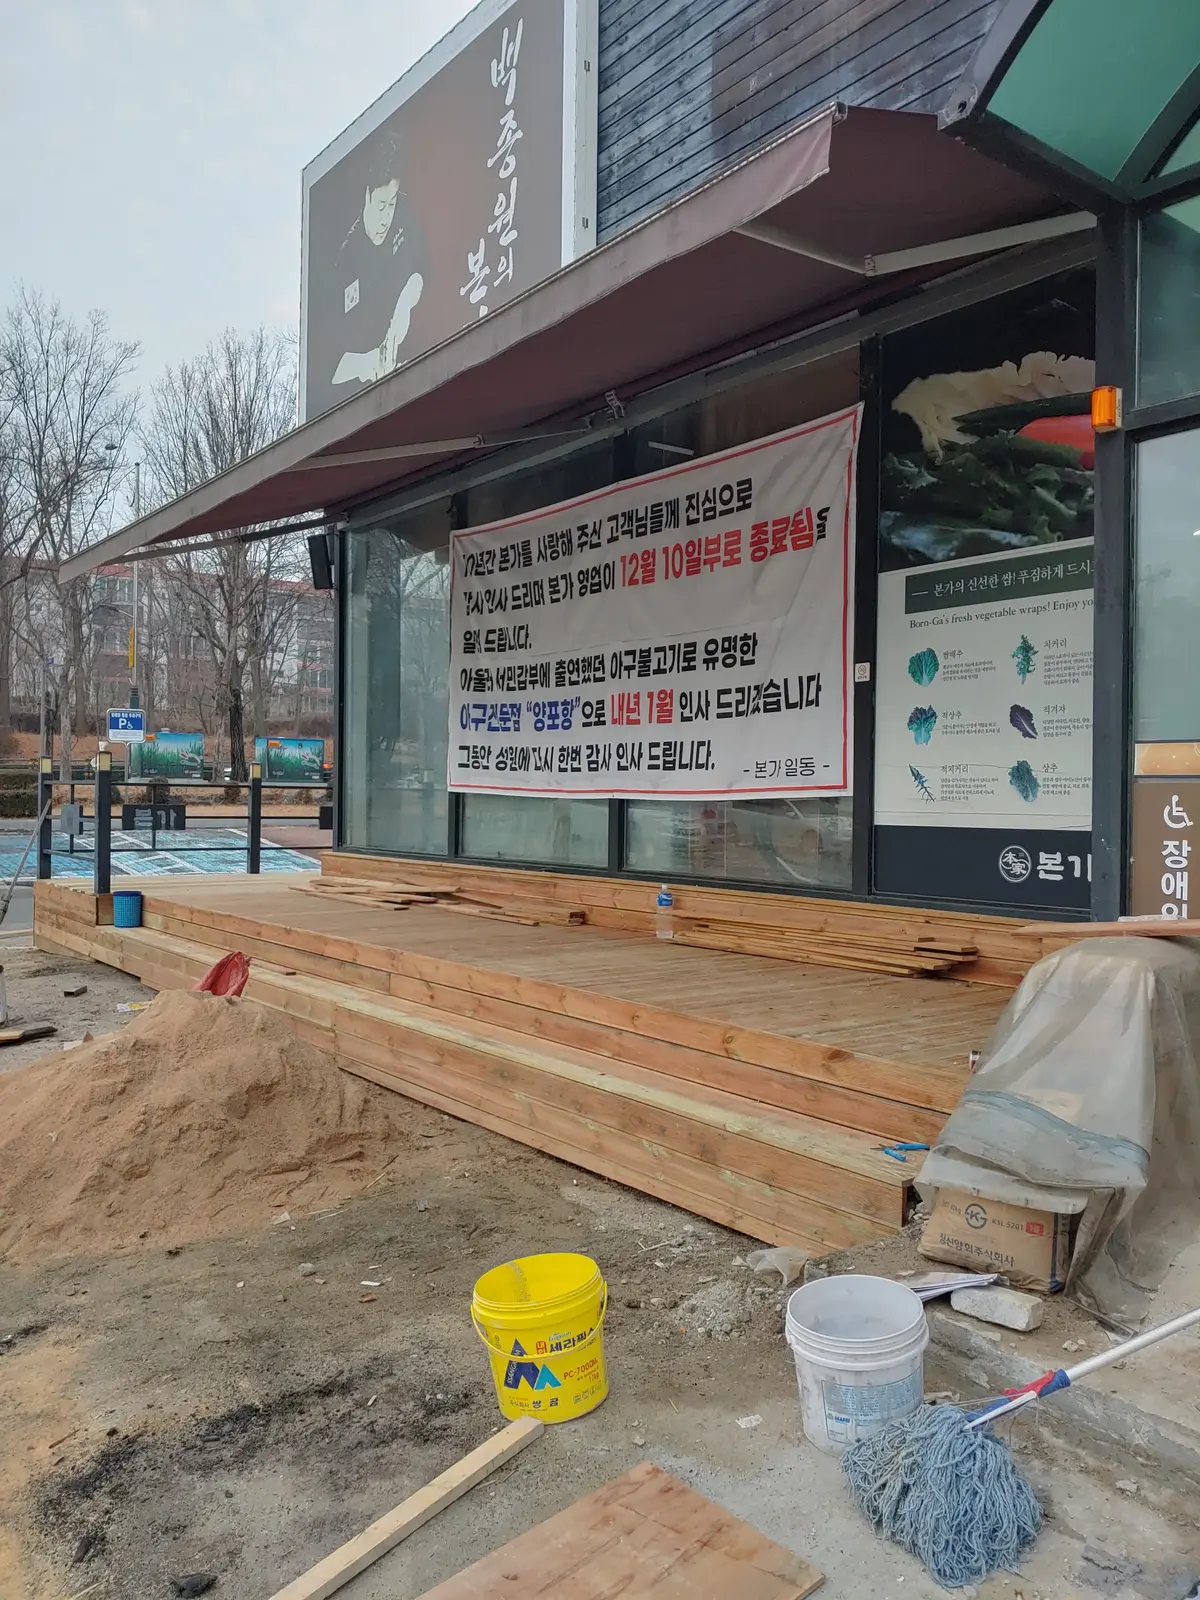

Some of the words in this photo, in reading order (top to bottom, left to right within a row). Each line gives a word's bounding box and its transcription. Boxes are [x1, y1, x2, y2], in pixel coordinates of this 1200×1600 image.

[460, 238, 490, 319] 본
[499, 539, 532, 572] 본가를
[536, 528, 573, 563] 사랑해
[577, 519, 602, 553] 주신
[607, 498, 679, 544] 고객님들께
[685, 478, 752, 526] 진심으로
[511, 579, 545, 610] 드리며
[548, 572, 574, 603] 본가
[577, 561, 615, 597] 영업이
[620, 549, 656, 588] 12월
[662, 529, 742, 580] 10일부로
[934, 580, 964, 597] 본가의
[967, 573, 1000, 592] 신선한
[1017, 563, 1063, 585] 푸짐하게
[1066, 559, 1094, 576] 드시
[909, 614, 950, 629] Born-Ga's
[951, 611, 973, 624] fresh
[975, 606, 1017, 622] vegetable
[1019, 601, 1050, 616] wraps!
[1052, 599, 1080, 613] Enjoy
[484, 624, 532, 652] 드립니다.
[1044, 638, 1067, 649] 치커리
[496, 661, 551, 692] 서민갑부에
[555, 653, 606, 687] 출연했던
[610, 641, 697, 680] 아구불고기로
[702, 632, 758, 671] 유명한
[611, 692, 640, 726] 내년
[647, 689, 674, 724] 1월
[679, 690, 710, 723] 인사
[716, 672, 822, 719] 드리겠습니다
[118, 718, 127, 729] P
[458, 745, 492, 770] 그동안
[495, 746, 531, 772] 성원에
[558, 744, 582, 772] 한번
[586, 743, 611, 772] 감사
[616, 742, 643, 772] 인사
[647, 740, 715, 771] 드립니다.
[754, 759, 781, 779] 본가
[785, 757, 816, 776] 일동
[1042, 763, 1058, 773] 상추
[1006, 1221, 1023, 1231] 5201
